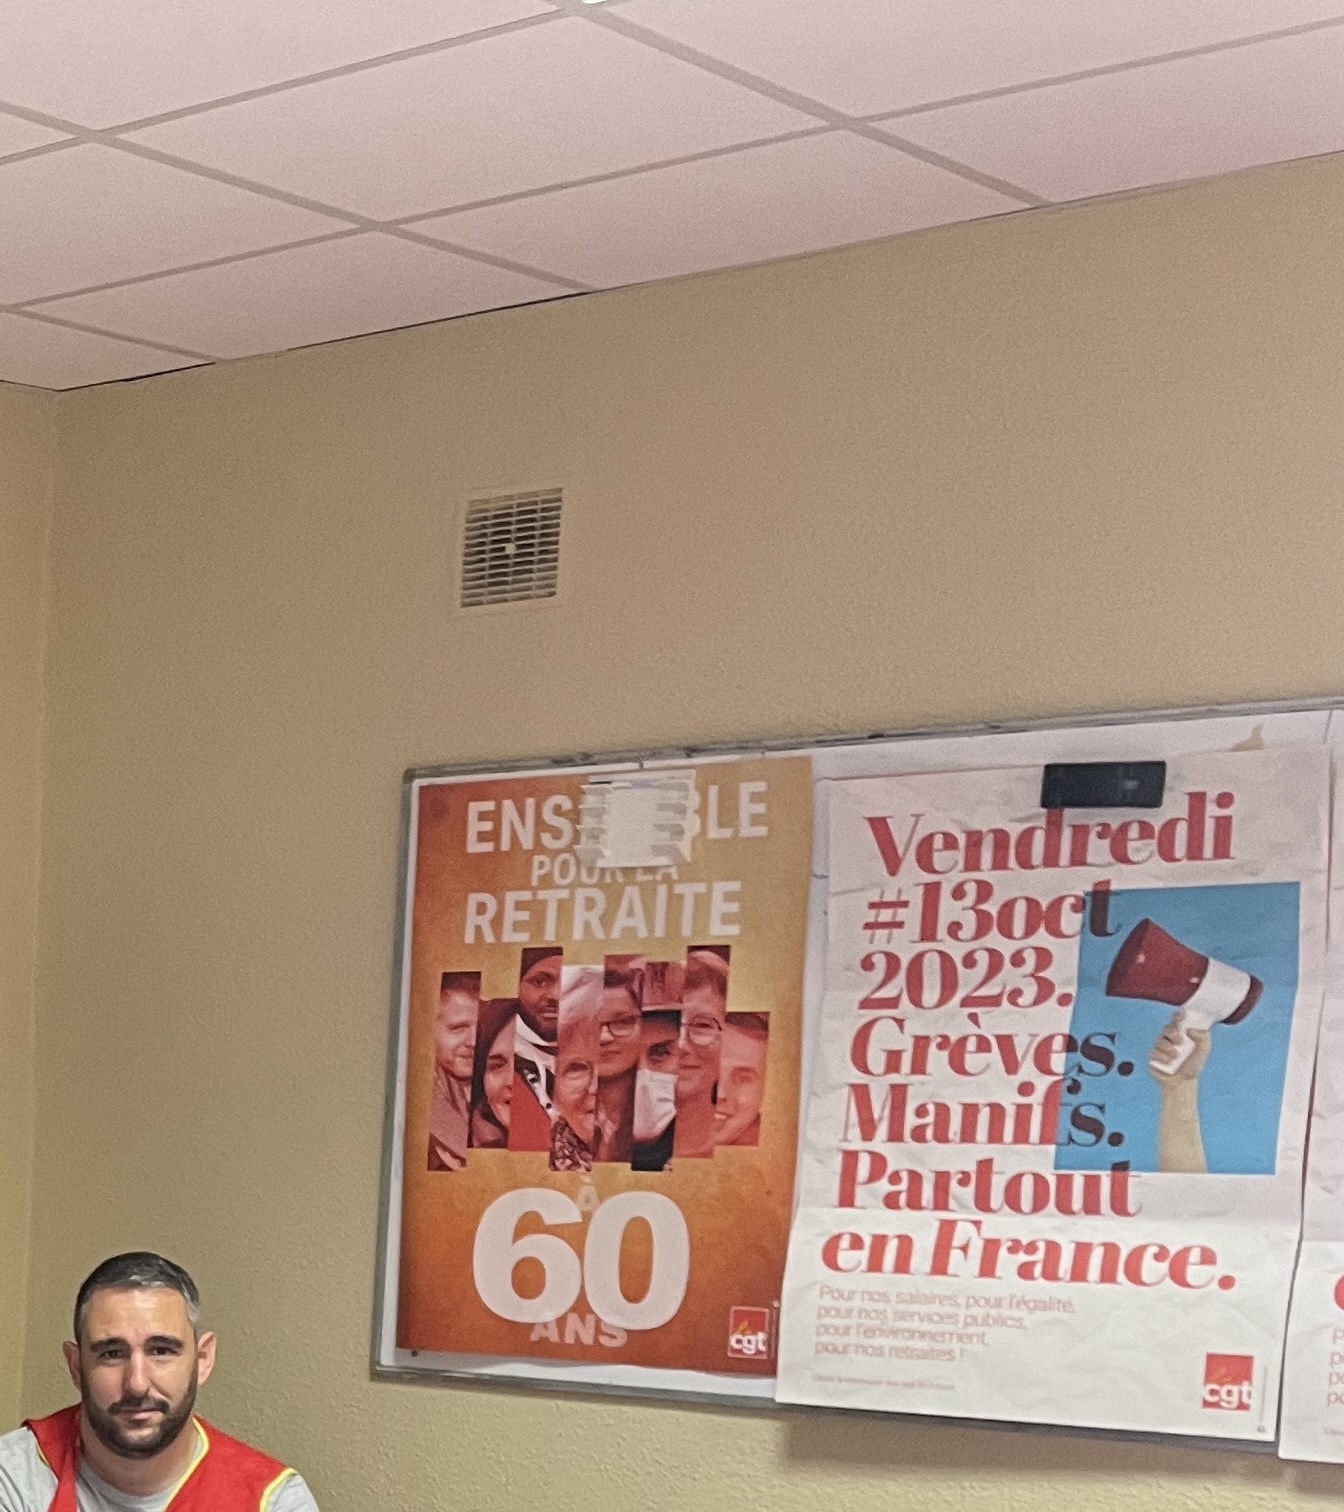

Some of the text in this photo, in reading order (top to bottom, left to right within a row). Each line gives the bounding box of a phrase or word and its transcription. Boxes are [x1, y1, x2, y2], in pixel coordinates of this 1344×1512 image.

[466, 781, 769, 854] ENSLE
[866, 791, 1235, 877] Vendredi
[465, 880, 742, 943] RETRAITE
[862, 878, 1122, 947] #13oct
[857, 947, 1075, 1012] 2023.
[850, 1012, 1134, 1079] Grèves.
[840, 1078, 1126, 1149] Manifs.
[834, 1149, 1142, 1217] Partout
[473, 1187, 690, 1331] 60
[820, 1217, 1236, 1292] en France.
[819, 1284, 858, 1302] Pour
[529, 1311, 628, 1348] ANS
[729, 1331, 768, 1354] cgt
[1202, 1379, 1254, 1409] cgt
